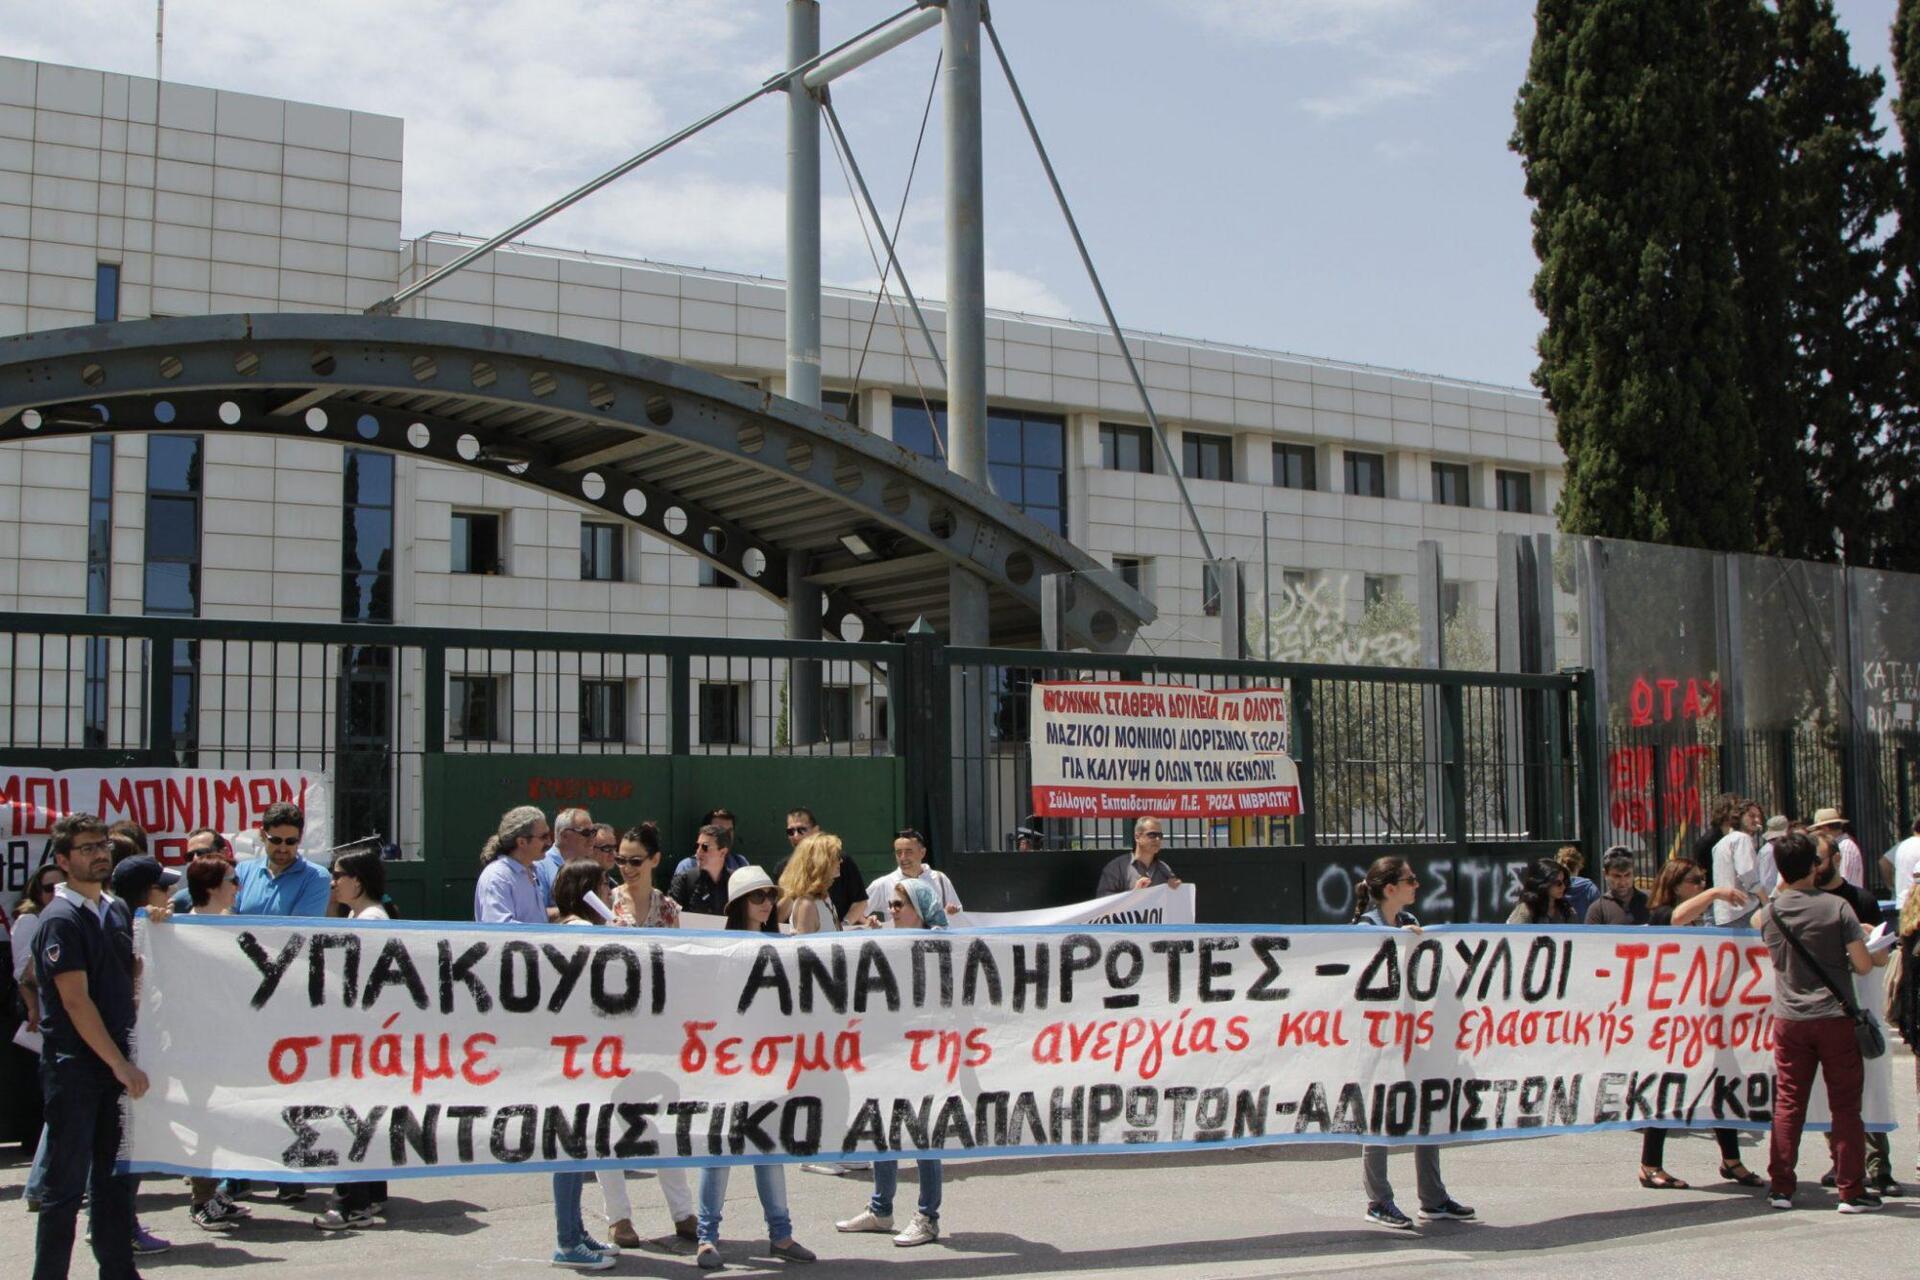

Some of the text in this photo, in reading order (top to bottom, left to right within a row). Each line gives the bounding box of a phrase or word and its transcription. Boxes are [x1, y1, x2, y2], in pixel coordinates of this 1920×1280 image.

[1043, 689, 1103, 714] ΜΟΝΙΜΗ
[1104, 691, 1166, 717] ΣΤΑΘΕΡΗ
[1168, 694, 1218, 720] ΔΟΥΛΕΙΑ
[1222, 702, 1239, 721] ΓΙΑ
[1046, 722, 1109, 747] ΜΑΖΙΚΟΙ
[1115, 726, 1176, 750] ΜΟΝΙΜΟΙ
[1179, 728, 1249, 751] ΔΙΟΡΙΣΜΟΙ
[1062, 756, 1276, 782] ΓΙΑ ΚΑΛΥΨΗ ΟΛΩΝ ΤΩΝ ΚΕΝΩΝ!
[1048, 790, 1097, 814] Σύλλογος
[1101, 793, 1176, 811] Εκπαιδευτικών
[1181, 794, 1200, 811] Π.Ε.
[235, 930, 666, 1016] ΥΠΑΚΟΥΟΙ
[737, 934, 1291, 1014] ΑΝΑΠΛΗΡΩΤΕΣ
[268, 1012, 501, 1096] σπάμε
[550, 1034, 631, 1080] τα
[680, 1018, 866, 1090] δεσμά
[905, 1027, 992, 1083] της
[1031, 1008, 1250, 1079] ανεργίας
[1277, 1008, 1349, 1048] και
[1363, 1009, 1434, 1066] της
[1455, 1002, 1634, 1056] ελαστικής
[281, 1095, 822, 1167] ΣΥΝΤΟΝΙΣΤΙΚΟ
[1594, 1067, 1778, 1126] ΕΚΠ/ΚΩ
